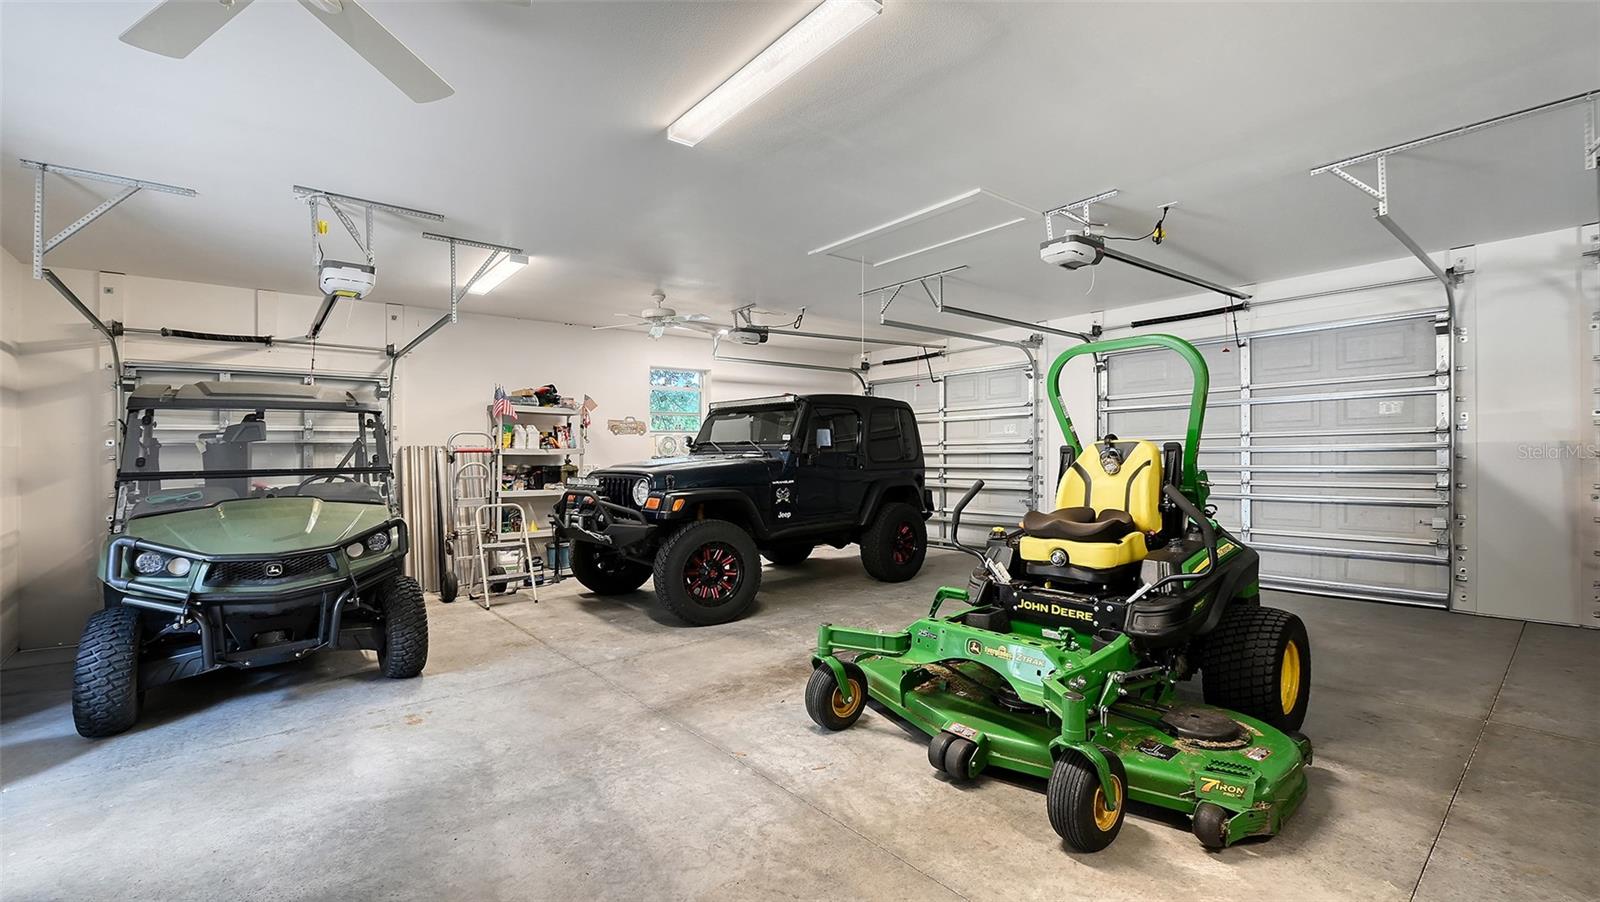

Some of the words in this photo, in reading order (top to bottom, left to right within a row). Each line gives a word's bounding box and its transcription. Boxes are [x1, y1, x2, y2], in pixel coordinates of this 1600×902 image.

[777, 511, 792, 519] Jeep
[1017, 598, 1049, 613] JOHN
[1051, 604, 1094, 621] DEERE
